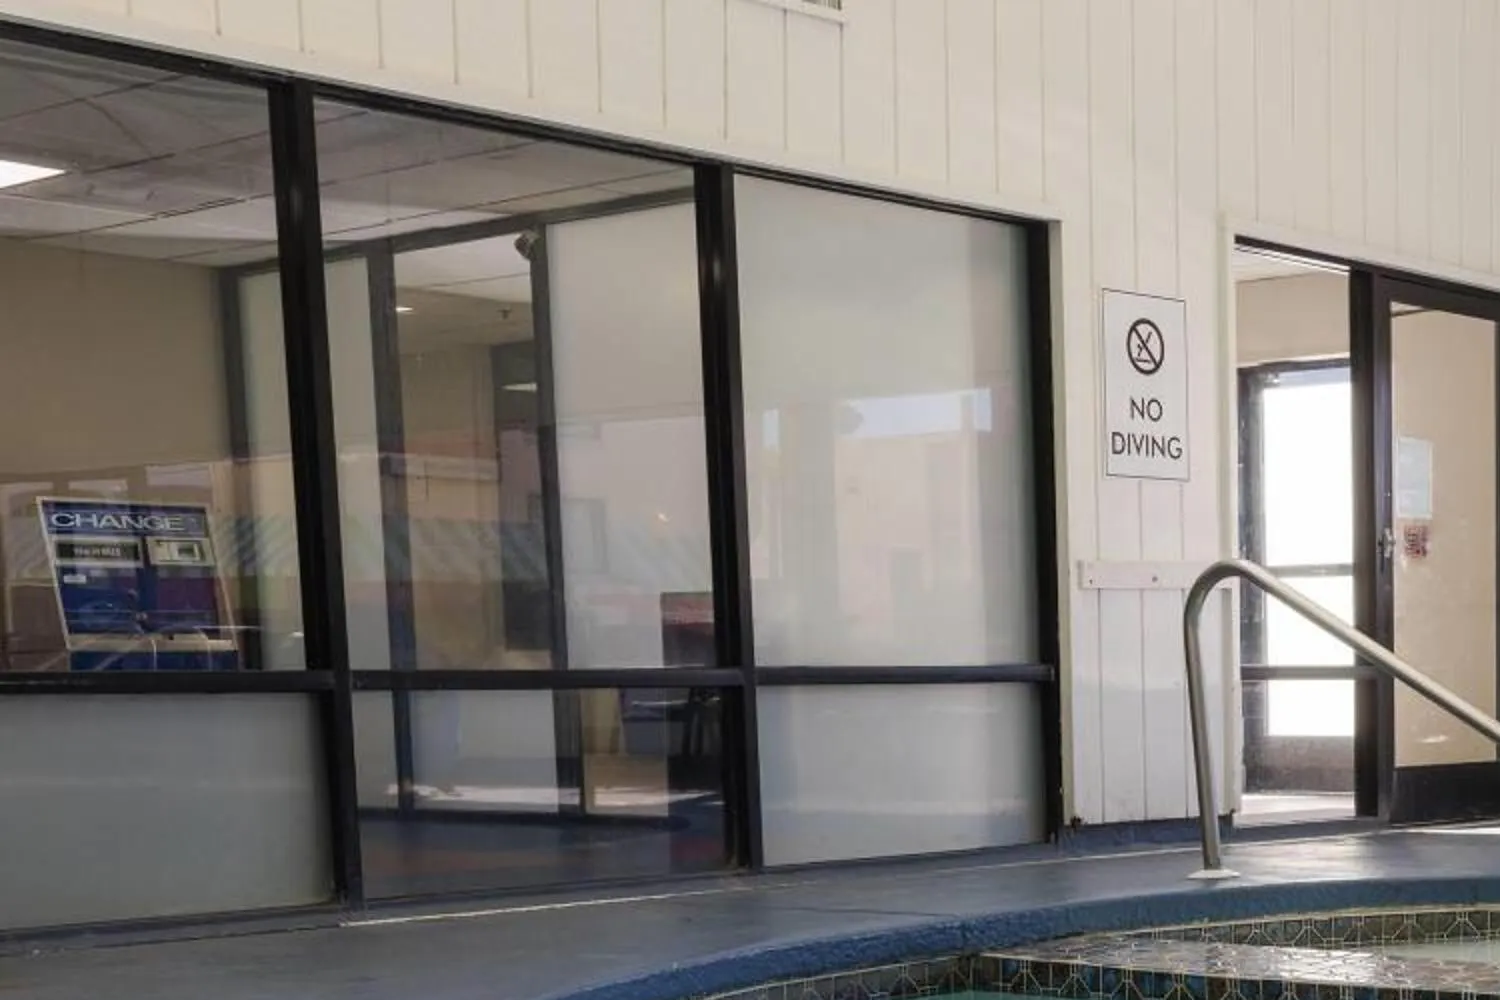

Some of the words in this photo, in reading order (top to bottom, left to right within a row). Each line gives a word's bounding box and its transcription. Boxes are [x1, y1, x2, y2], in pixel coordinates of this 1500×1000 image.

[1130, 396, 1163, 423] NO
[1111, 431, 1183, 461] DIVING
[50, 511, 186, 532] CHANGE
